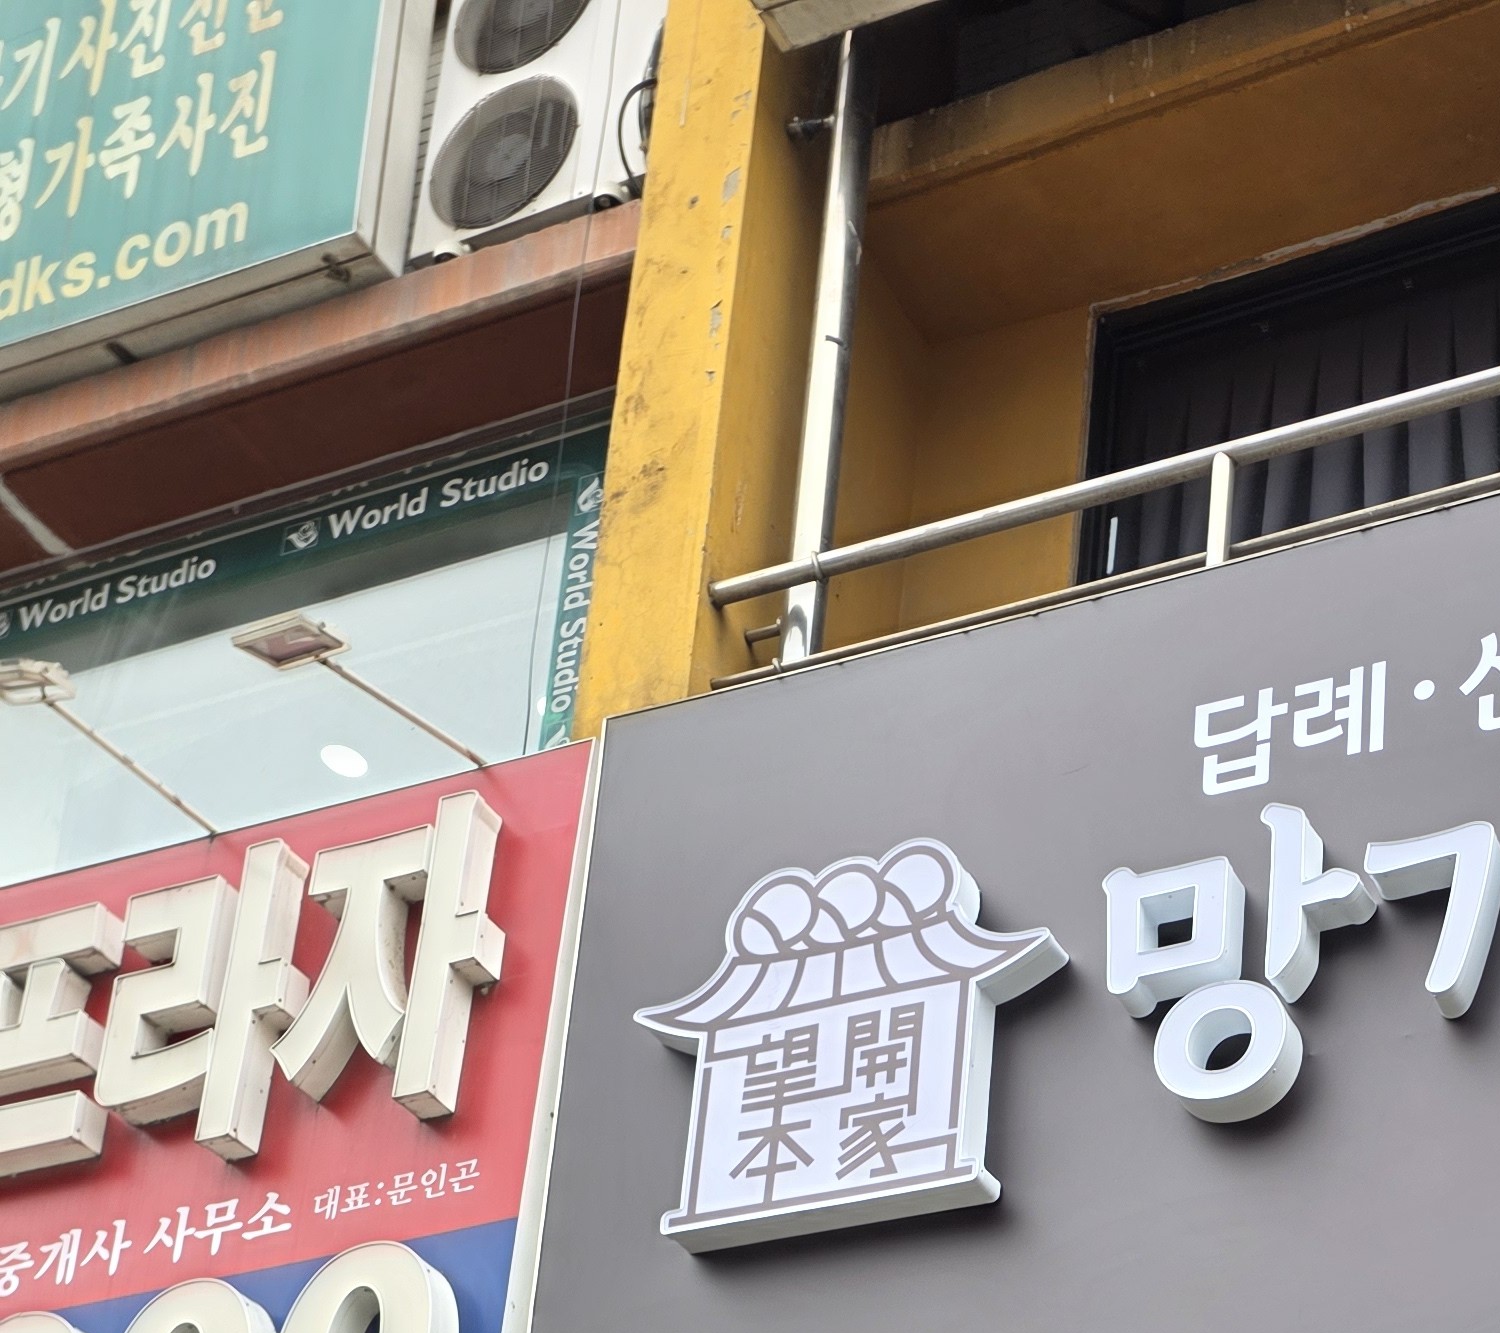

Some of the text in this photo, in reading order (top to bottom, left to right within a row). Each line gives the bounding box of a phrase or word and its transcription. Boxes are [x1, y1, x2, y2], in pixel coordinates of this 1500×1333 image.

[0, 0, 284, 117] 기사진
[327, 458, 550, 539] World Studio
[18, 555, 217, 632] World Studio
[550, 519, 600, 713] World Studio
[144, 1191, 293, 1264] 사무소
